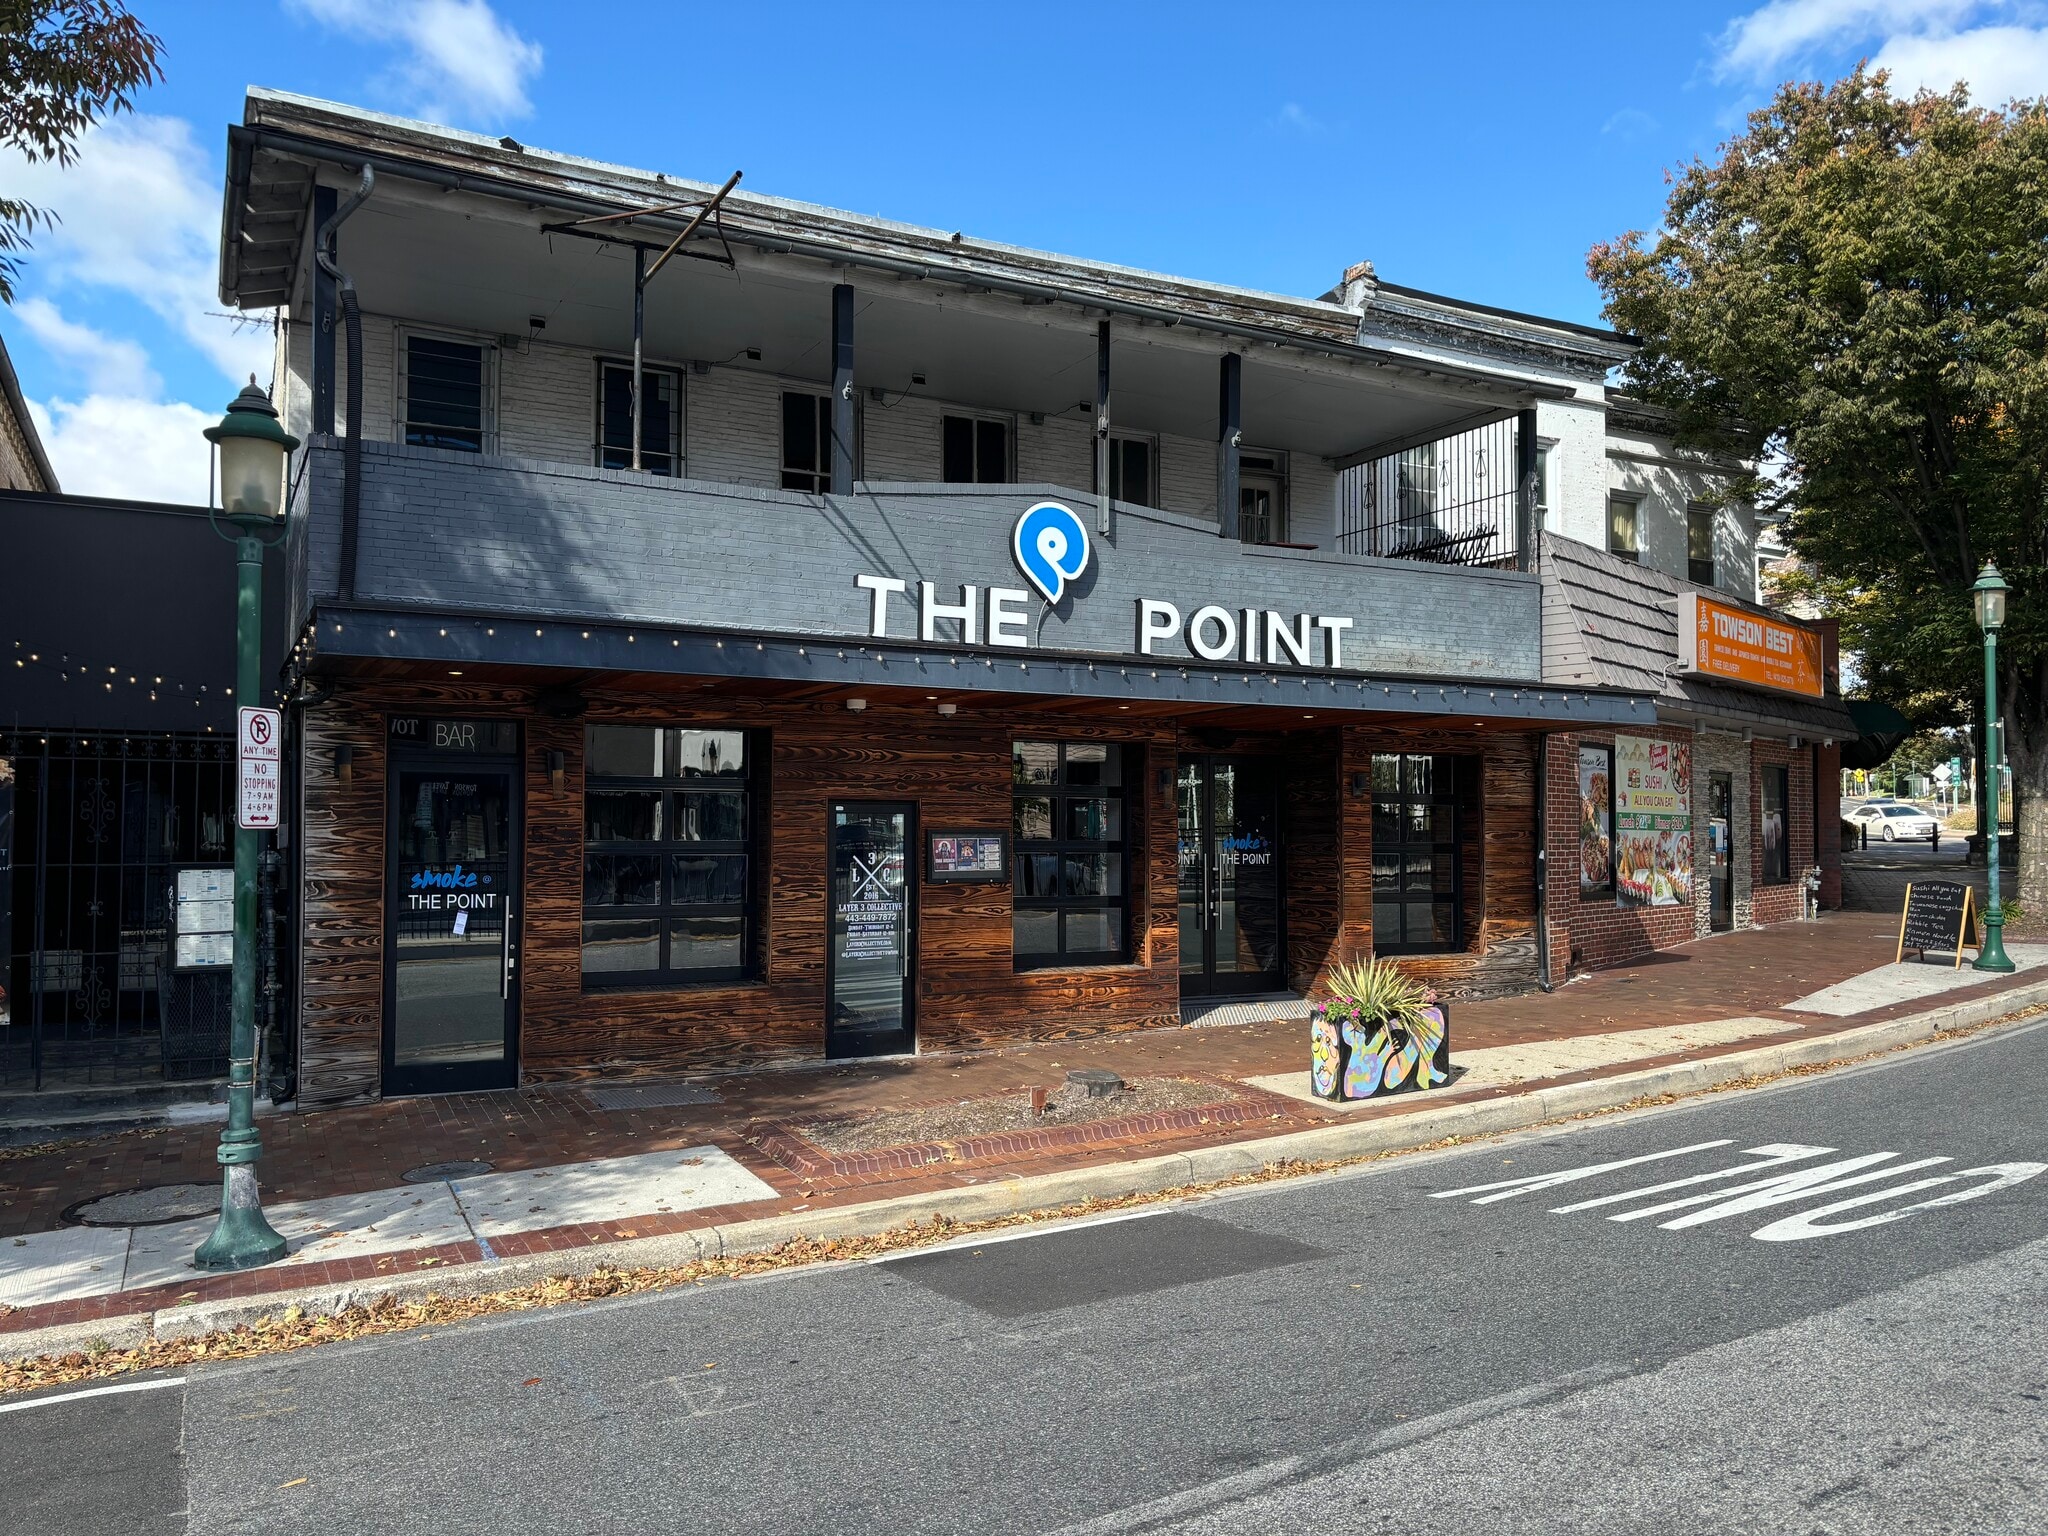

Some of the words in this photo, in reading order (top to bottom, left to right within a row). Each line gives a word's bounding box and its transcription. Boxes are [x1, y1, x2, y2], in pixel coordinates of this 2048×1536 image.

[854, 574, 1029, 649] THE
[1135, 597, 1354, 669] POINT
[1712, 611, 1763, 647] TOWSON
[1765, 626, 1794, 655] BEST
[435, 723, 475, 752] BAR
[243, 746, 259, 755] ANY
[262, 747, 277, 756] TIME
[254, 763, 267, 775] NO
[244, 777, 276, 790] STOPPING
[1644, 775, 1663, 790] SUSHI
[1634, 795, 1643, 806] ALL
[1643, 795, 1654, 807] YOU
[1654, 796, 1664, 807] CAN
[1665, 797, 1674, 808] EAT
[1618, 814, 1635, 829] Lunch
[1655, 815, 1671, 830] Dinner
[1223, 833, 1260, 850] smoke
[1221, 853, 1240, 865] THE
[1242, 853, 1271, 865] POINT
[411, 865, 477, 889] smoke
[408, 895, 441, 910] THE
[447, 894, 497, 909] POINT
[864, 892, 879, 900] 2016
[839, 904, 859, 912] LAYER
[867, 903, 903, 911] COLLECTIVE
[845, 913, 897, 922] 443-449-7872
